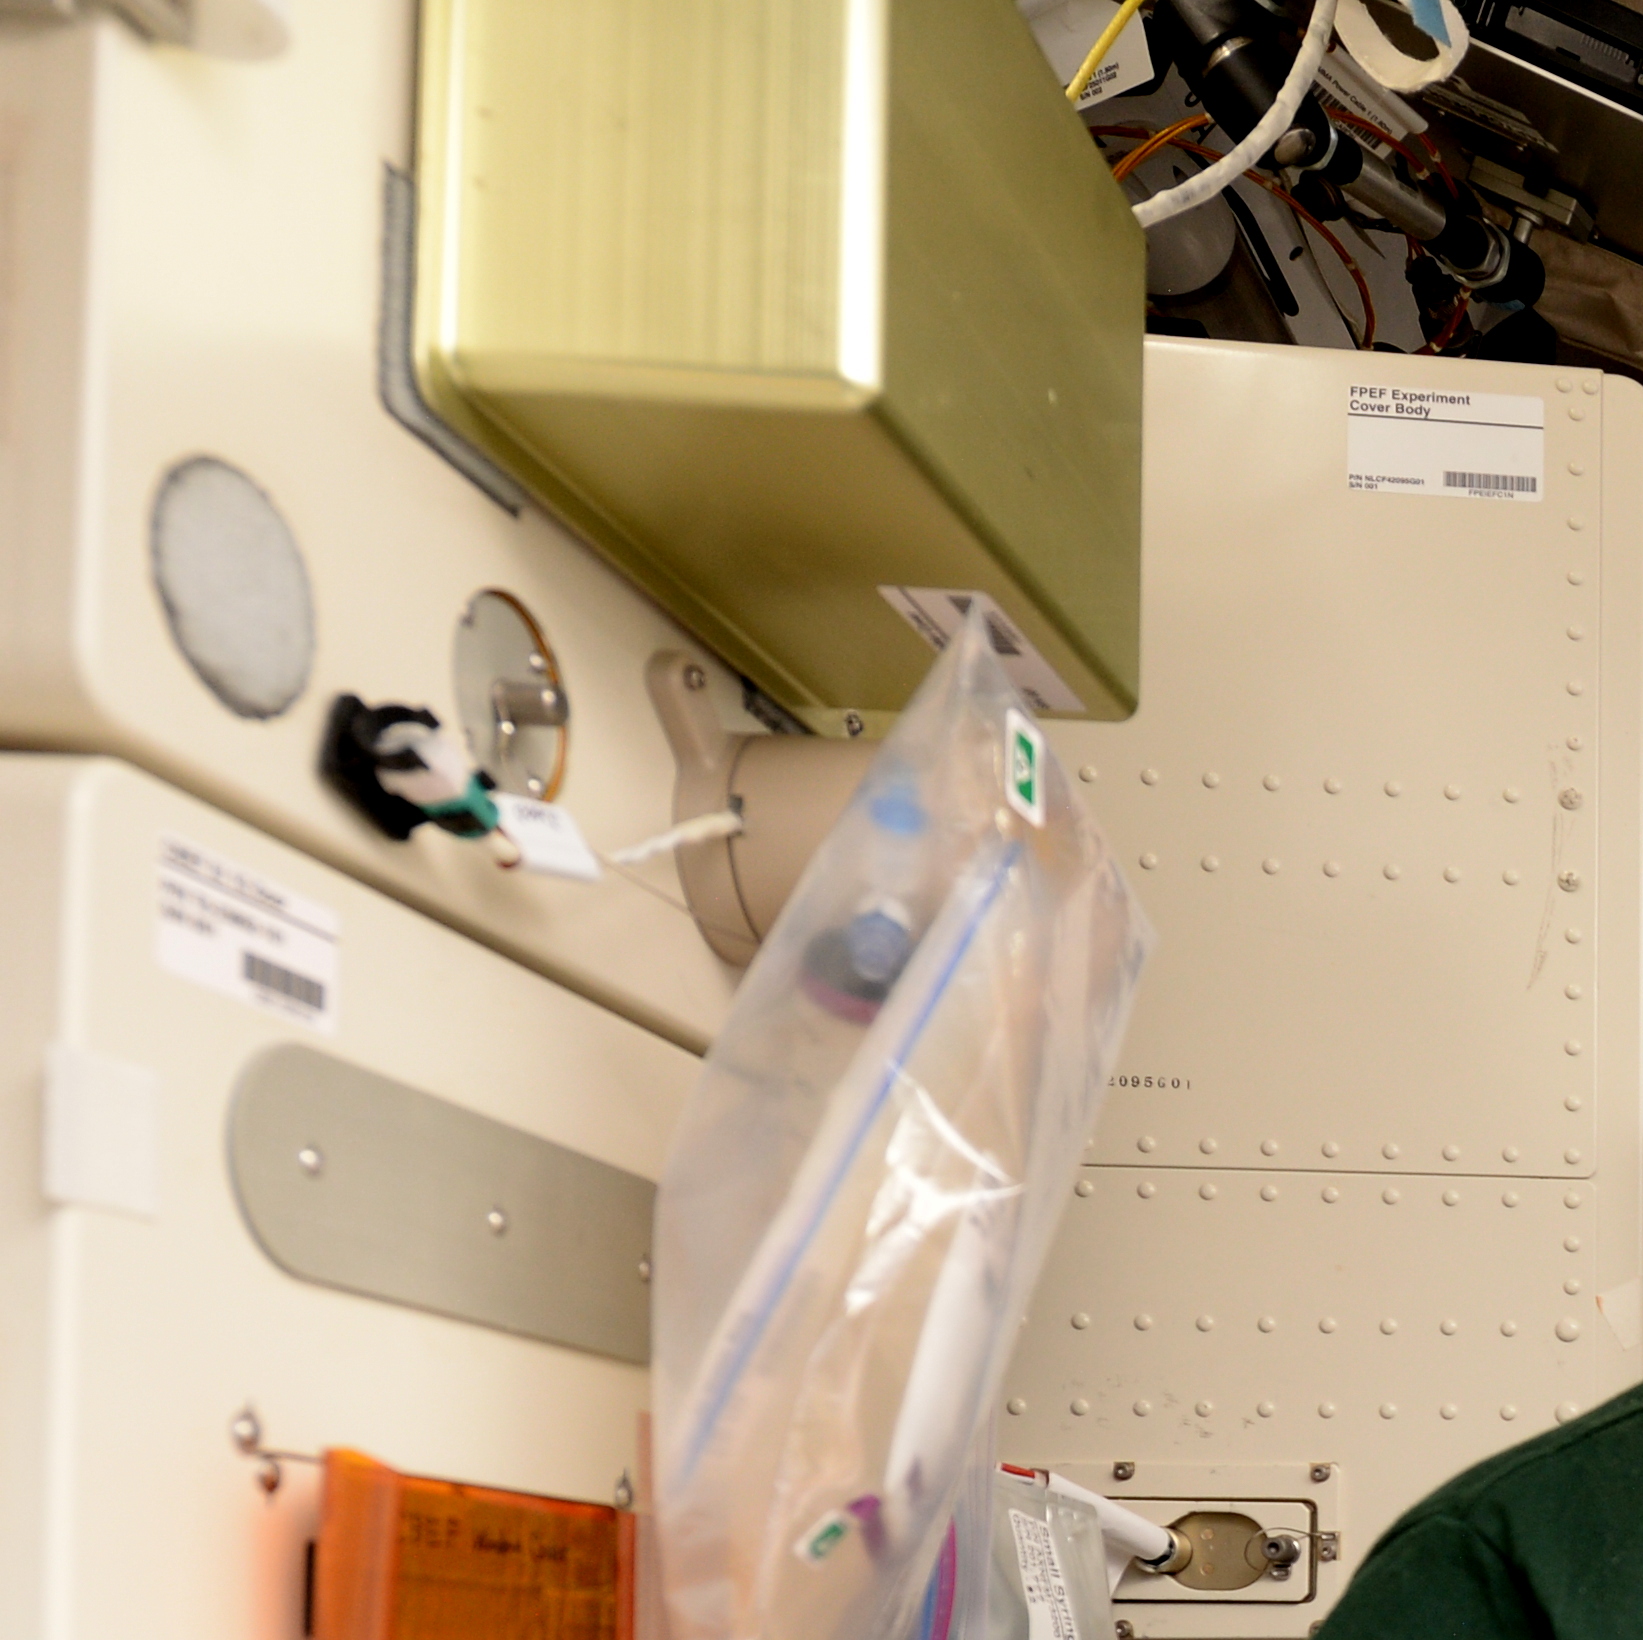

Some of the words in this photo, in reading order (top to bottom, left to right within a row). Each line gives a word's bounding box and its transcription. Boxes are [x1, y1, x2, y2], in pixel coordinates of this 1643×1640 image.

[1330, 79, 1352, 99] Power
[1347, 94, 1369, 113] Cable
[1349, 400, 1390, 413] Cover
[1395, 403, 1431, 419] Body
[1350, 386, 1387, 399] FPEF
[1392, 389, 1471, 406] Experiment
[1039, 1526, 1060, 1579] Small
